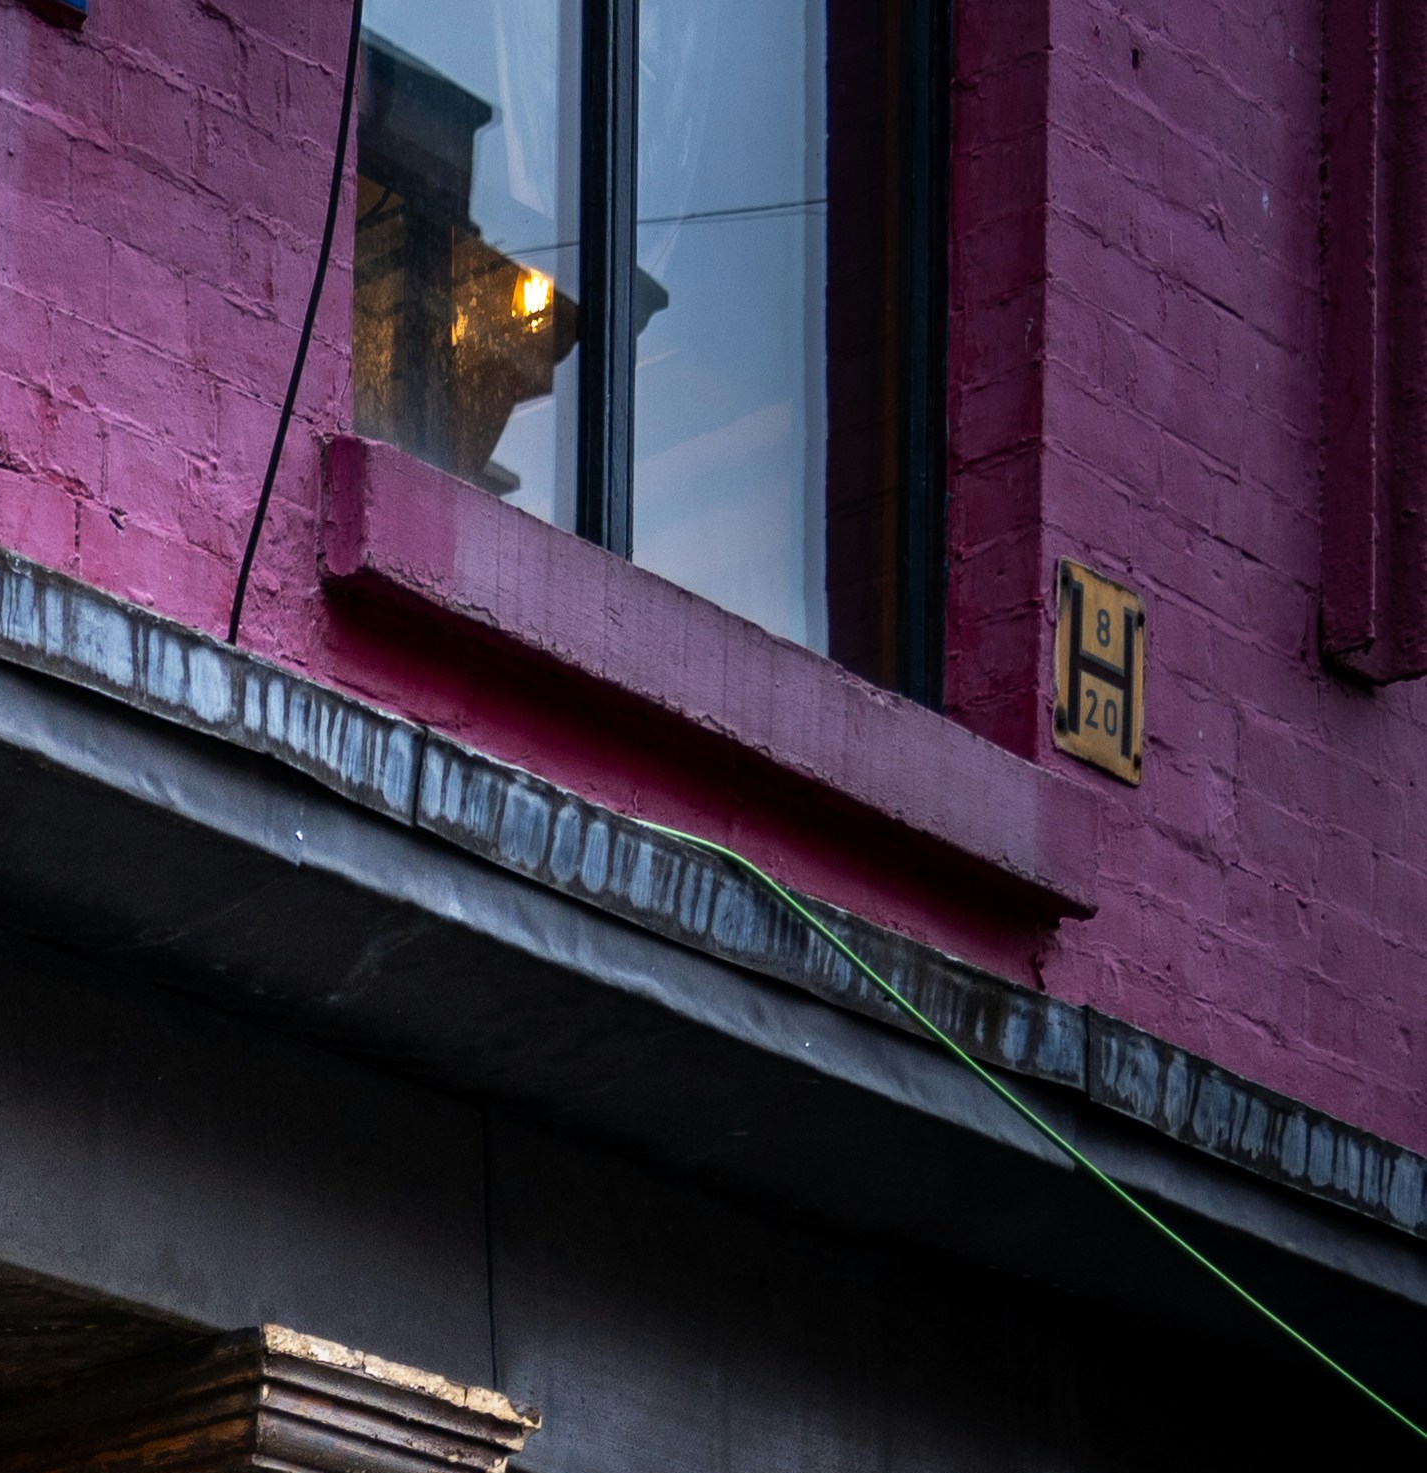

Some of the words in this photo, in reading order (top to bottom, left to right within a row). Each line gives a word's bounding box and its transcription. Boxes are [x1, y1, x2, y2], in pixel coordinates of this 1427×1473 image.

[1095, 608, 1112, 648] 8
[1068, 582, 1135, 757] H
[1084, 687, 1119, 738] 20
